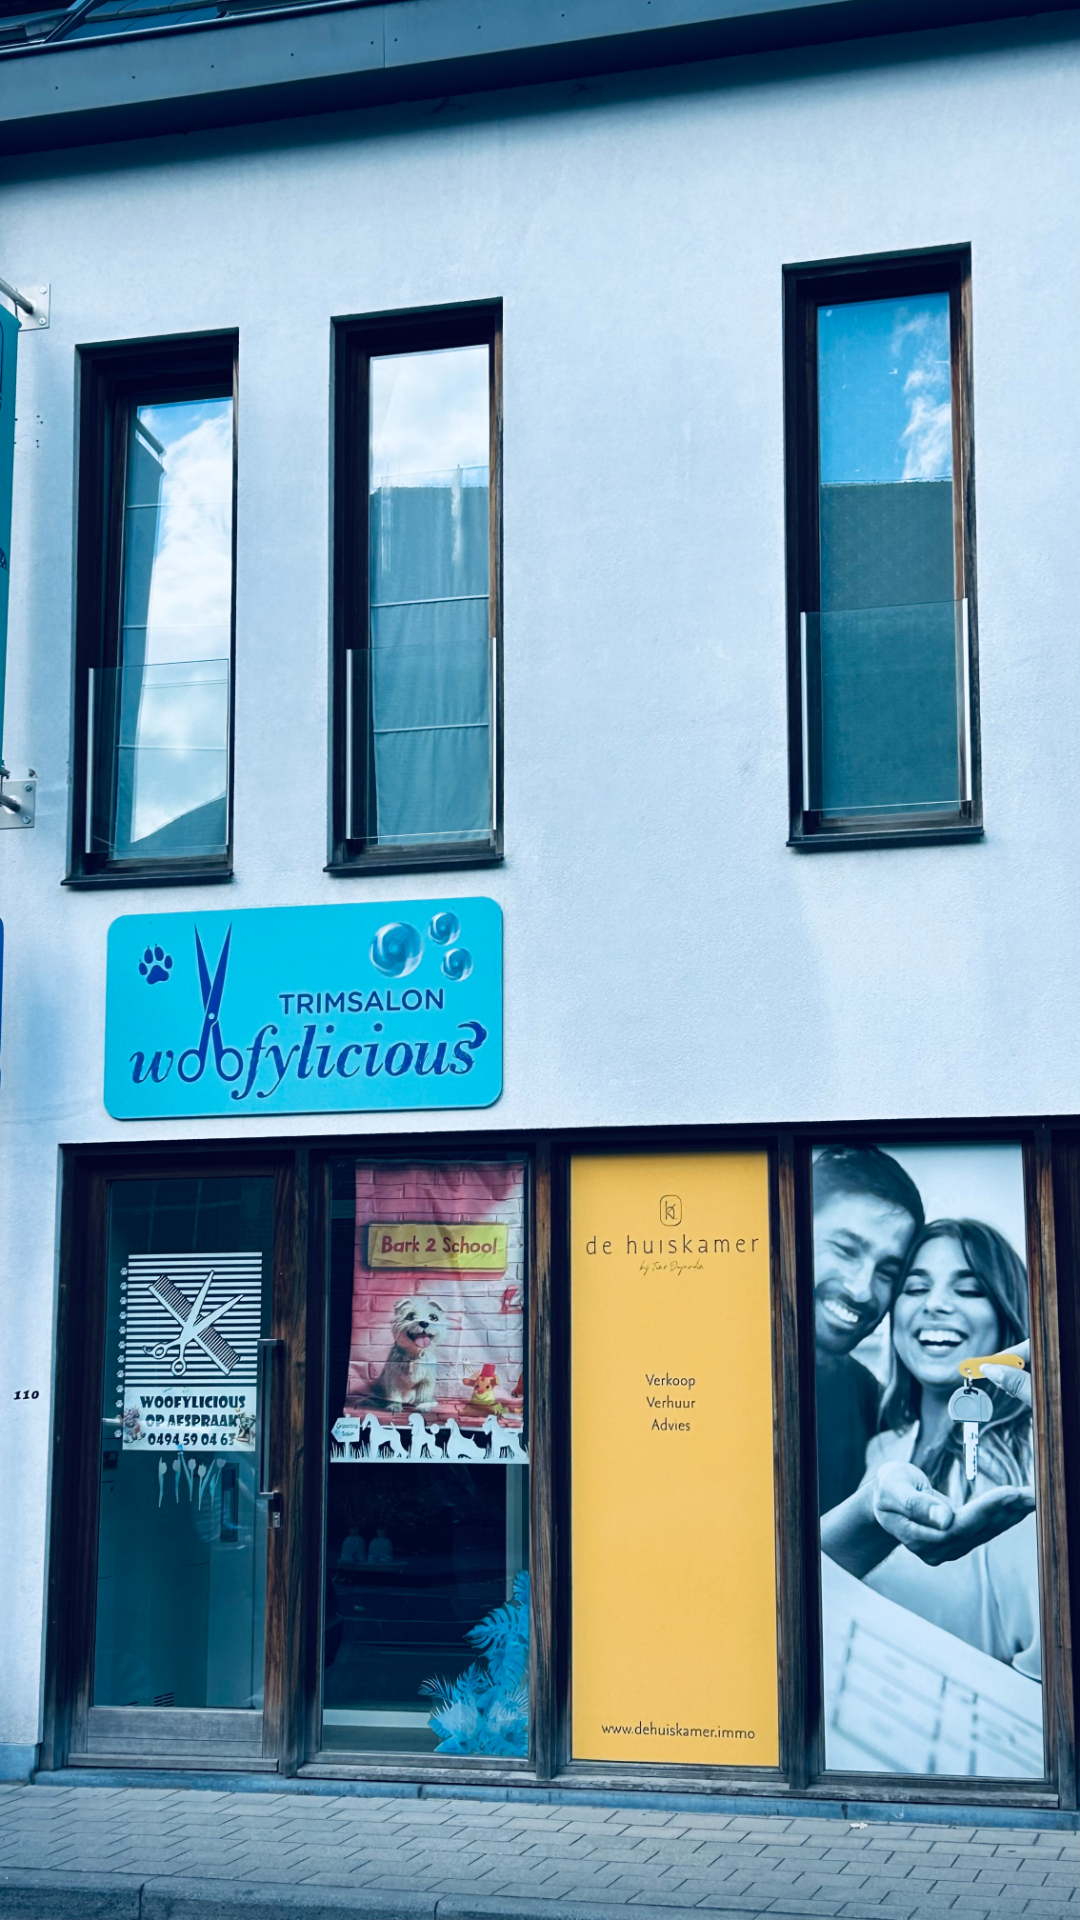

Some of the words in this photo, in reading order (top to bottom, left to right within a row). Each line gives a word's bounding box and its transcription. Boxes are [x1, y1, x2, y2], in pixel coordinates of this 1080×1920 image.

[279, 988, 444, 1015] TRIMSALON
[381, 1235, 420, 1254] Bark
[425, 1237, 437, 1252] 2
[442, 1236, 498, 1255] School
[586, 1235, 613, 1255] de
[626, 1233, 760, 1255] huiskamer
[645, 1372, 696, 1390] Verkoop
[13, 1390, 40, 1400] 110
[139, 1395, 246, 1409] WOOFYLICIOUS
[646, 1394, 696, 1409] Verhuur
[145, 1413, 165, 1428] OP
[651, 1417, 691, 1431] Advies
[147, 1432, 180, 1446] 0494
[183, 1432, 198, 1446] 59
[201, 1432, 218, 1446] 04
[601, 1720, 756, 1740] www.dehuiskamer.immo
